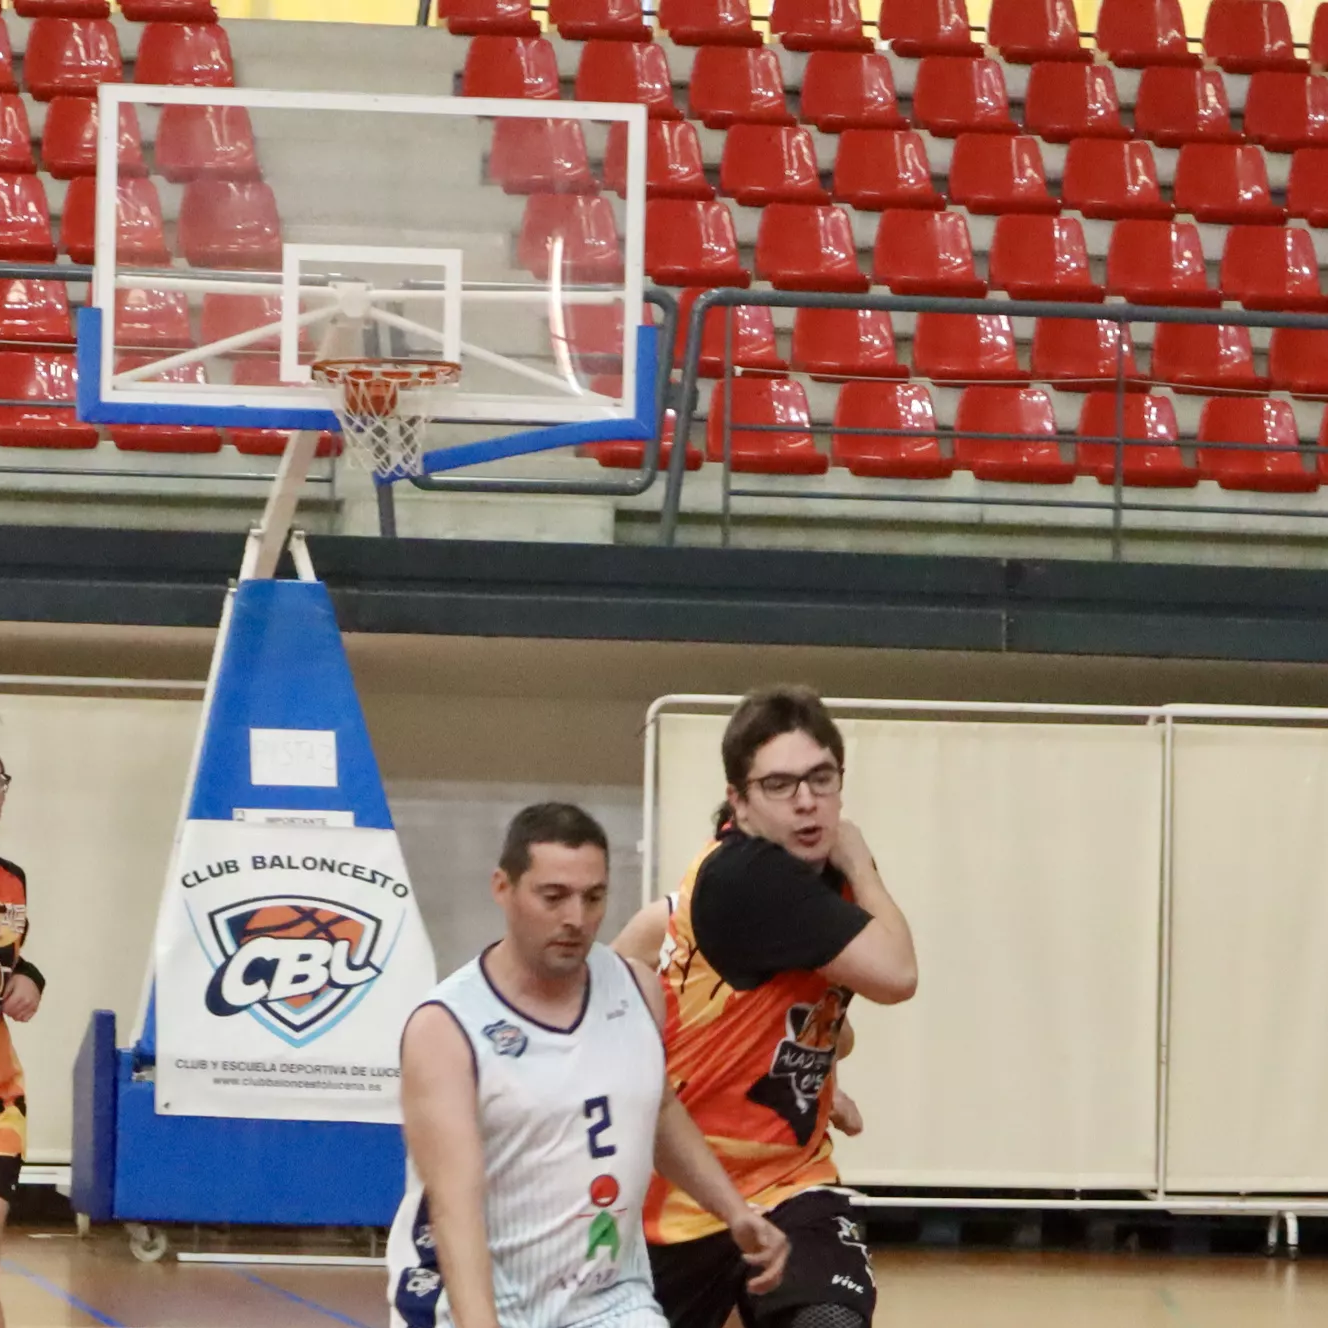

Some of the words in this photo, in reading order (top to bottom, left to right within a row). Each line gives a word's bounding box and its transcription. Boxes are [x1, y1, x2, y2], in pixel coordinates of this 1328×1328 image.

[181, 860, 240, 889] CLUB
[251, 855, 409, 898] BALONCESTO
[175, 1059, 207, 1070] CLUB
[210, 1060, 219, 1070] Y
[222, 1061, 277, 1073] ESCUELA
[279, 1063, 348, 1077] DEPORTIVA
[351, 1066, 367, 1077] DE
[583, 1095, 617, 1159] 2
